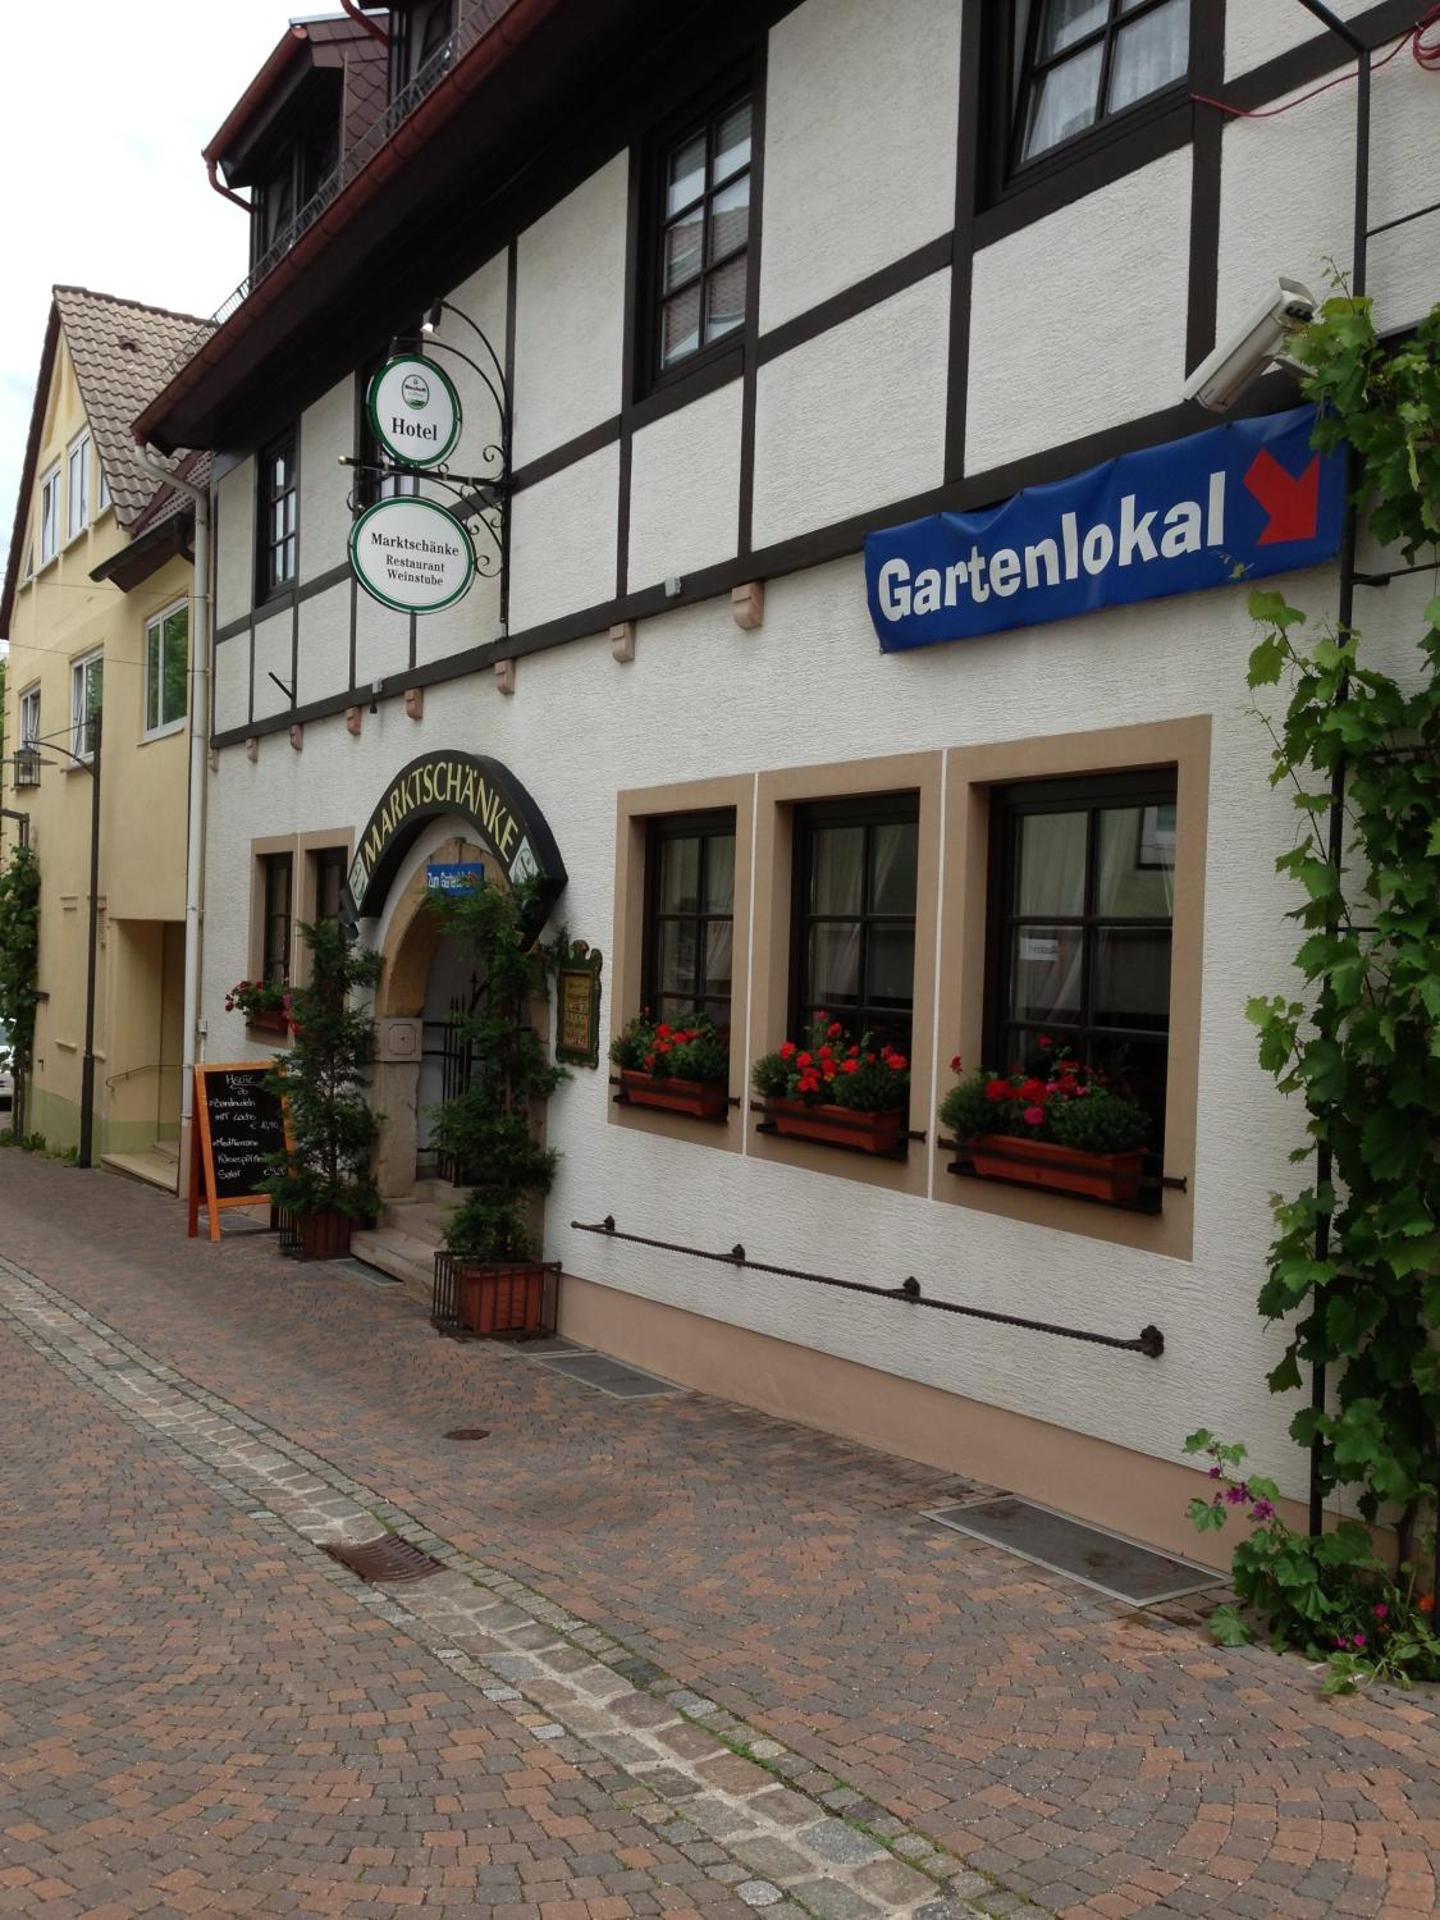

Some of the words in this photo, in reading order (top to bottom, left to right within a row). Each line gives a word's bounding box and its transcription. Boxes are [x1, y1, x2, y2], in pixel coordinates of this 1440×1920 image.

[391, 416, 438, 441] Hotel
[371, 532, 460, 557] Marktschänke
[878, 470, 1227, 622] Gartenlokal
[385, 554, 445, 573] Restaurant
[387, 568, 444, 586] Weinstube
[364, 762, 518, 873] MARKTSCHÄNKE
